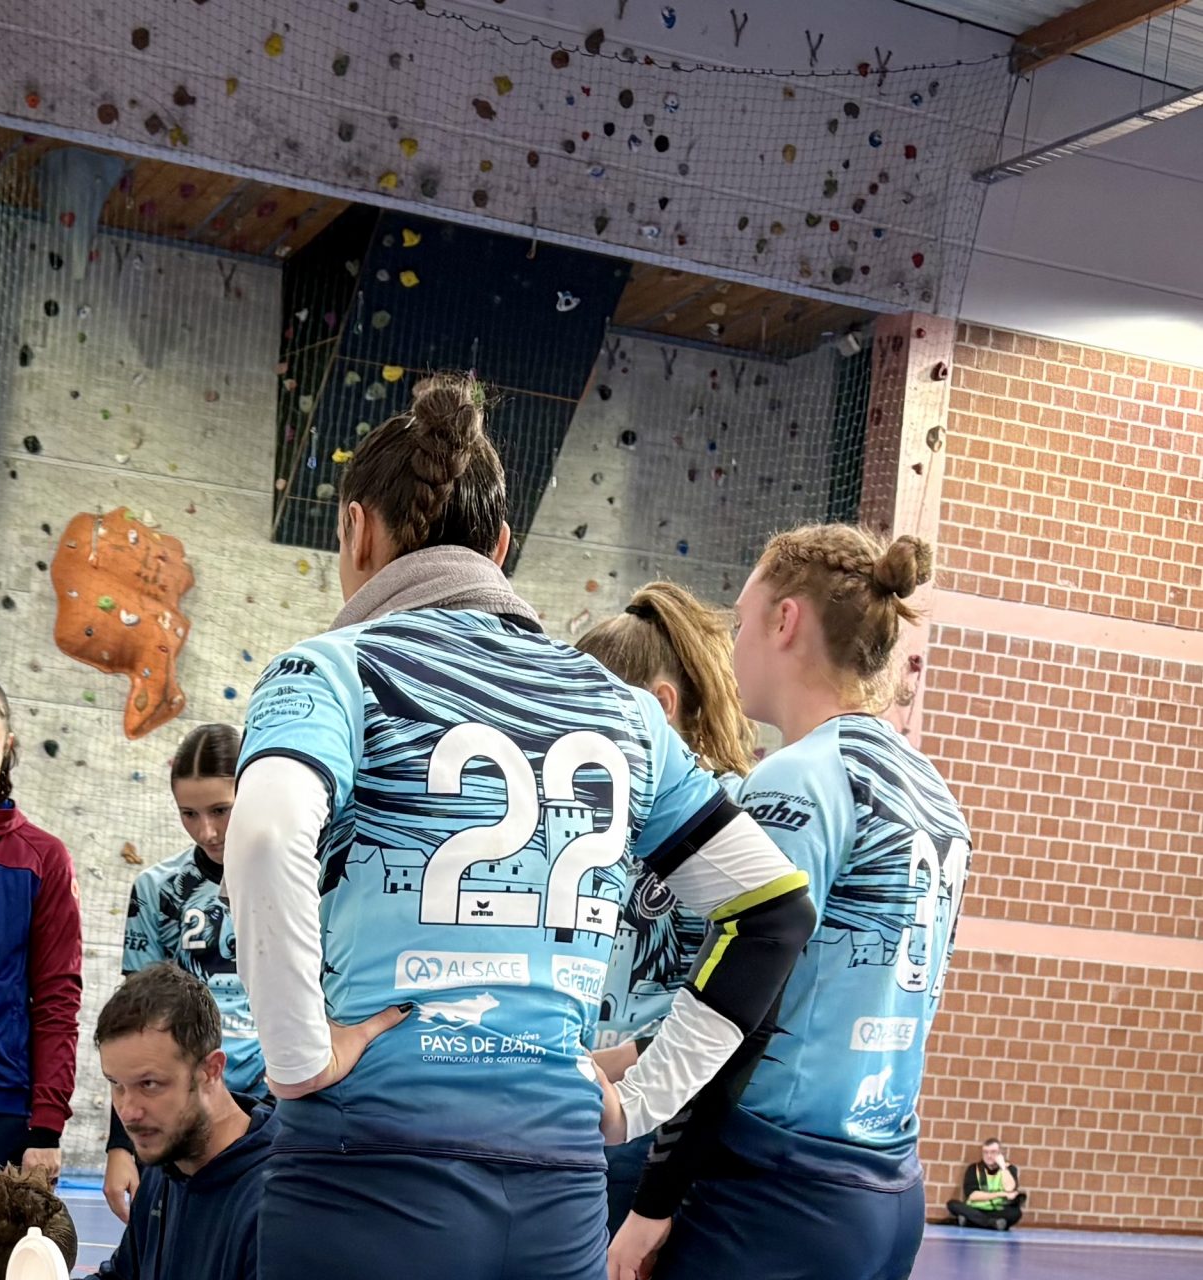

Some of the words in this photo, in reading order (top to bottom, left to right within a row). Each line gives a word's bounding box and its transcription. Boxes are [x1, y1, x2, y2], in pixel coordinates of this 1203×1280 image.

[419, 722, 631, 935] 22
[447, 960, 522, 979] ALSACE
[420, 1035, 467, 1052] PAYS
[471, 1037, 496, 1053] DE
